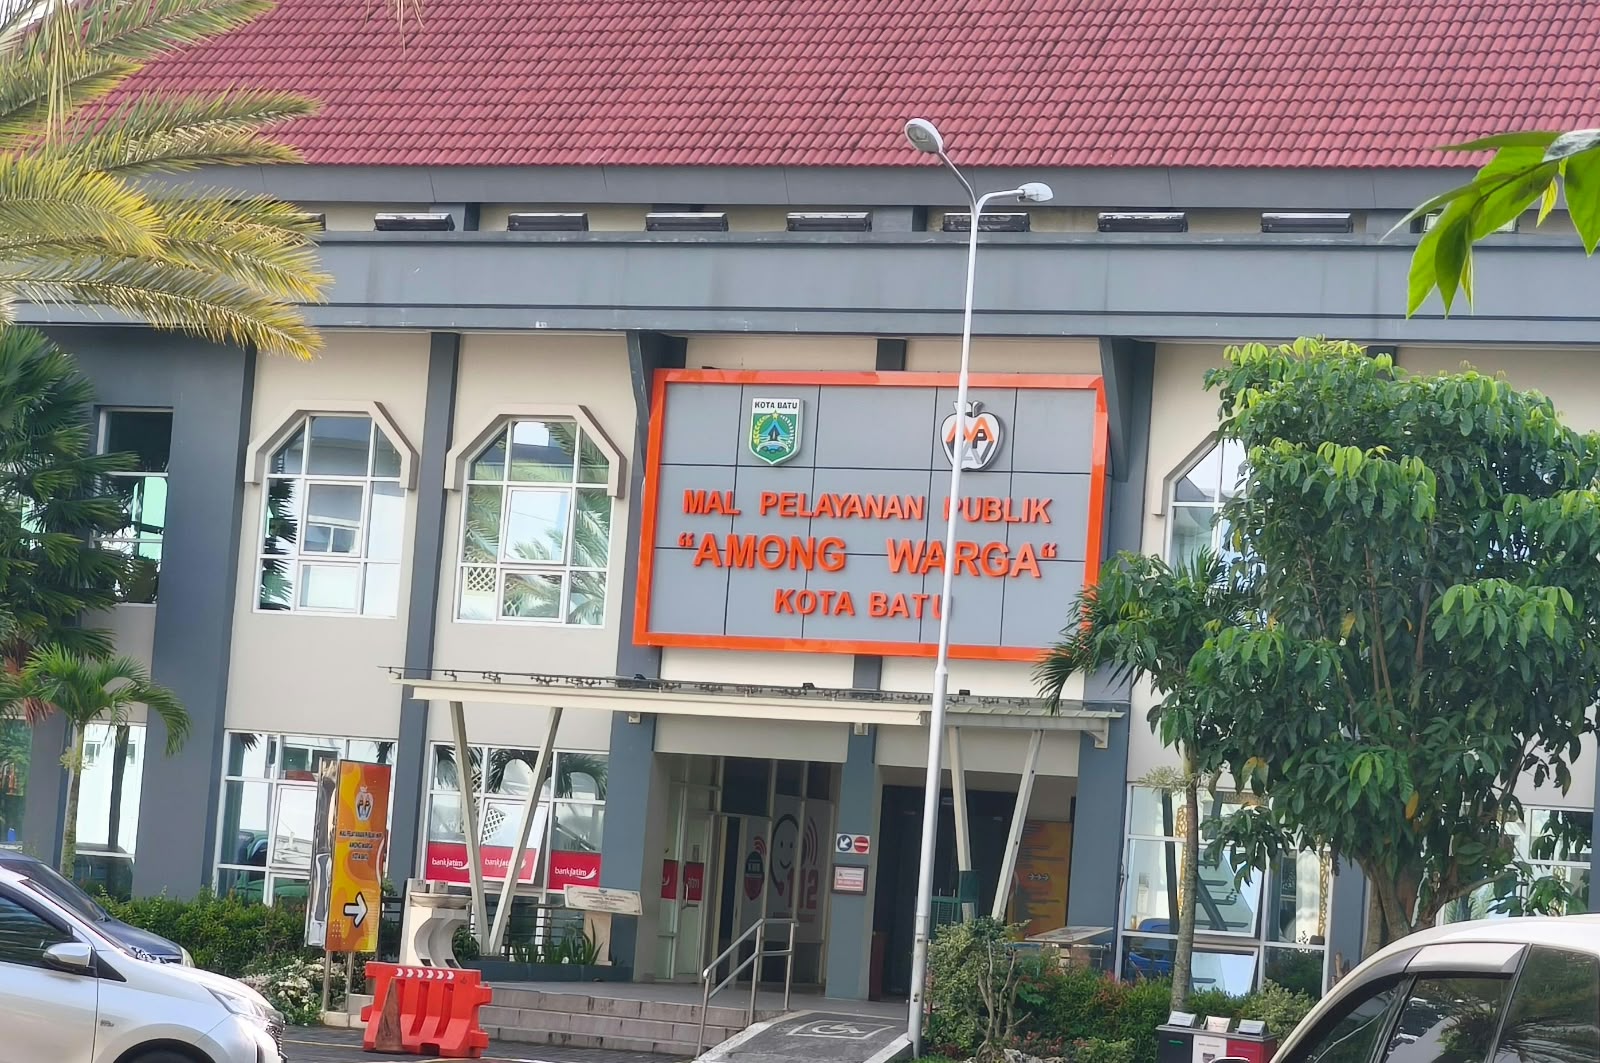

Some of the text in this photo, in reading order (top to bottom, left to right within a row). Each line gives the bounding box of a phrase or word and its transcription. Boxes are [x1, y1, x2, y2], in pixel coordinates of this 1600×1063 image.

[754, 401, 775, 409] KOTA
[683, 489, 741, 516] MAL
[760, 491, 924, 520] PELAYANAN
[678, 532, 847, 572] “AMONG
[774, 588, 855, 616] KOTA
[554, 866, 587, 877] bankjatim
